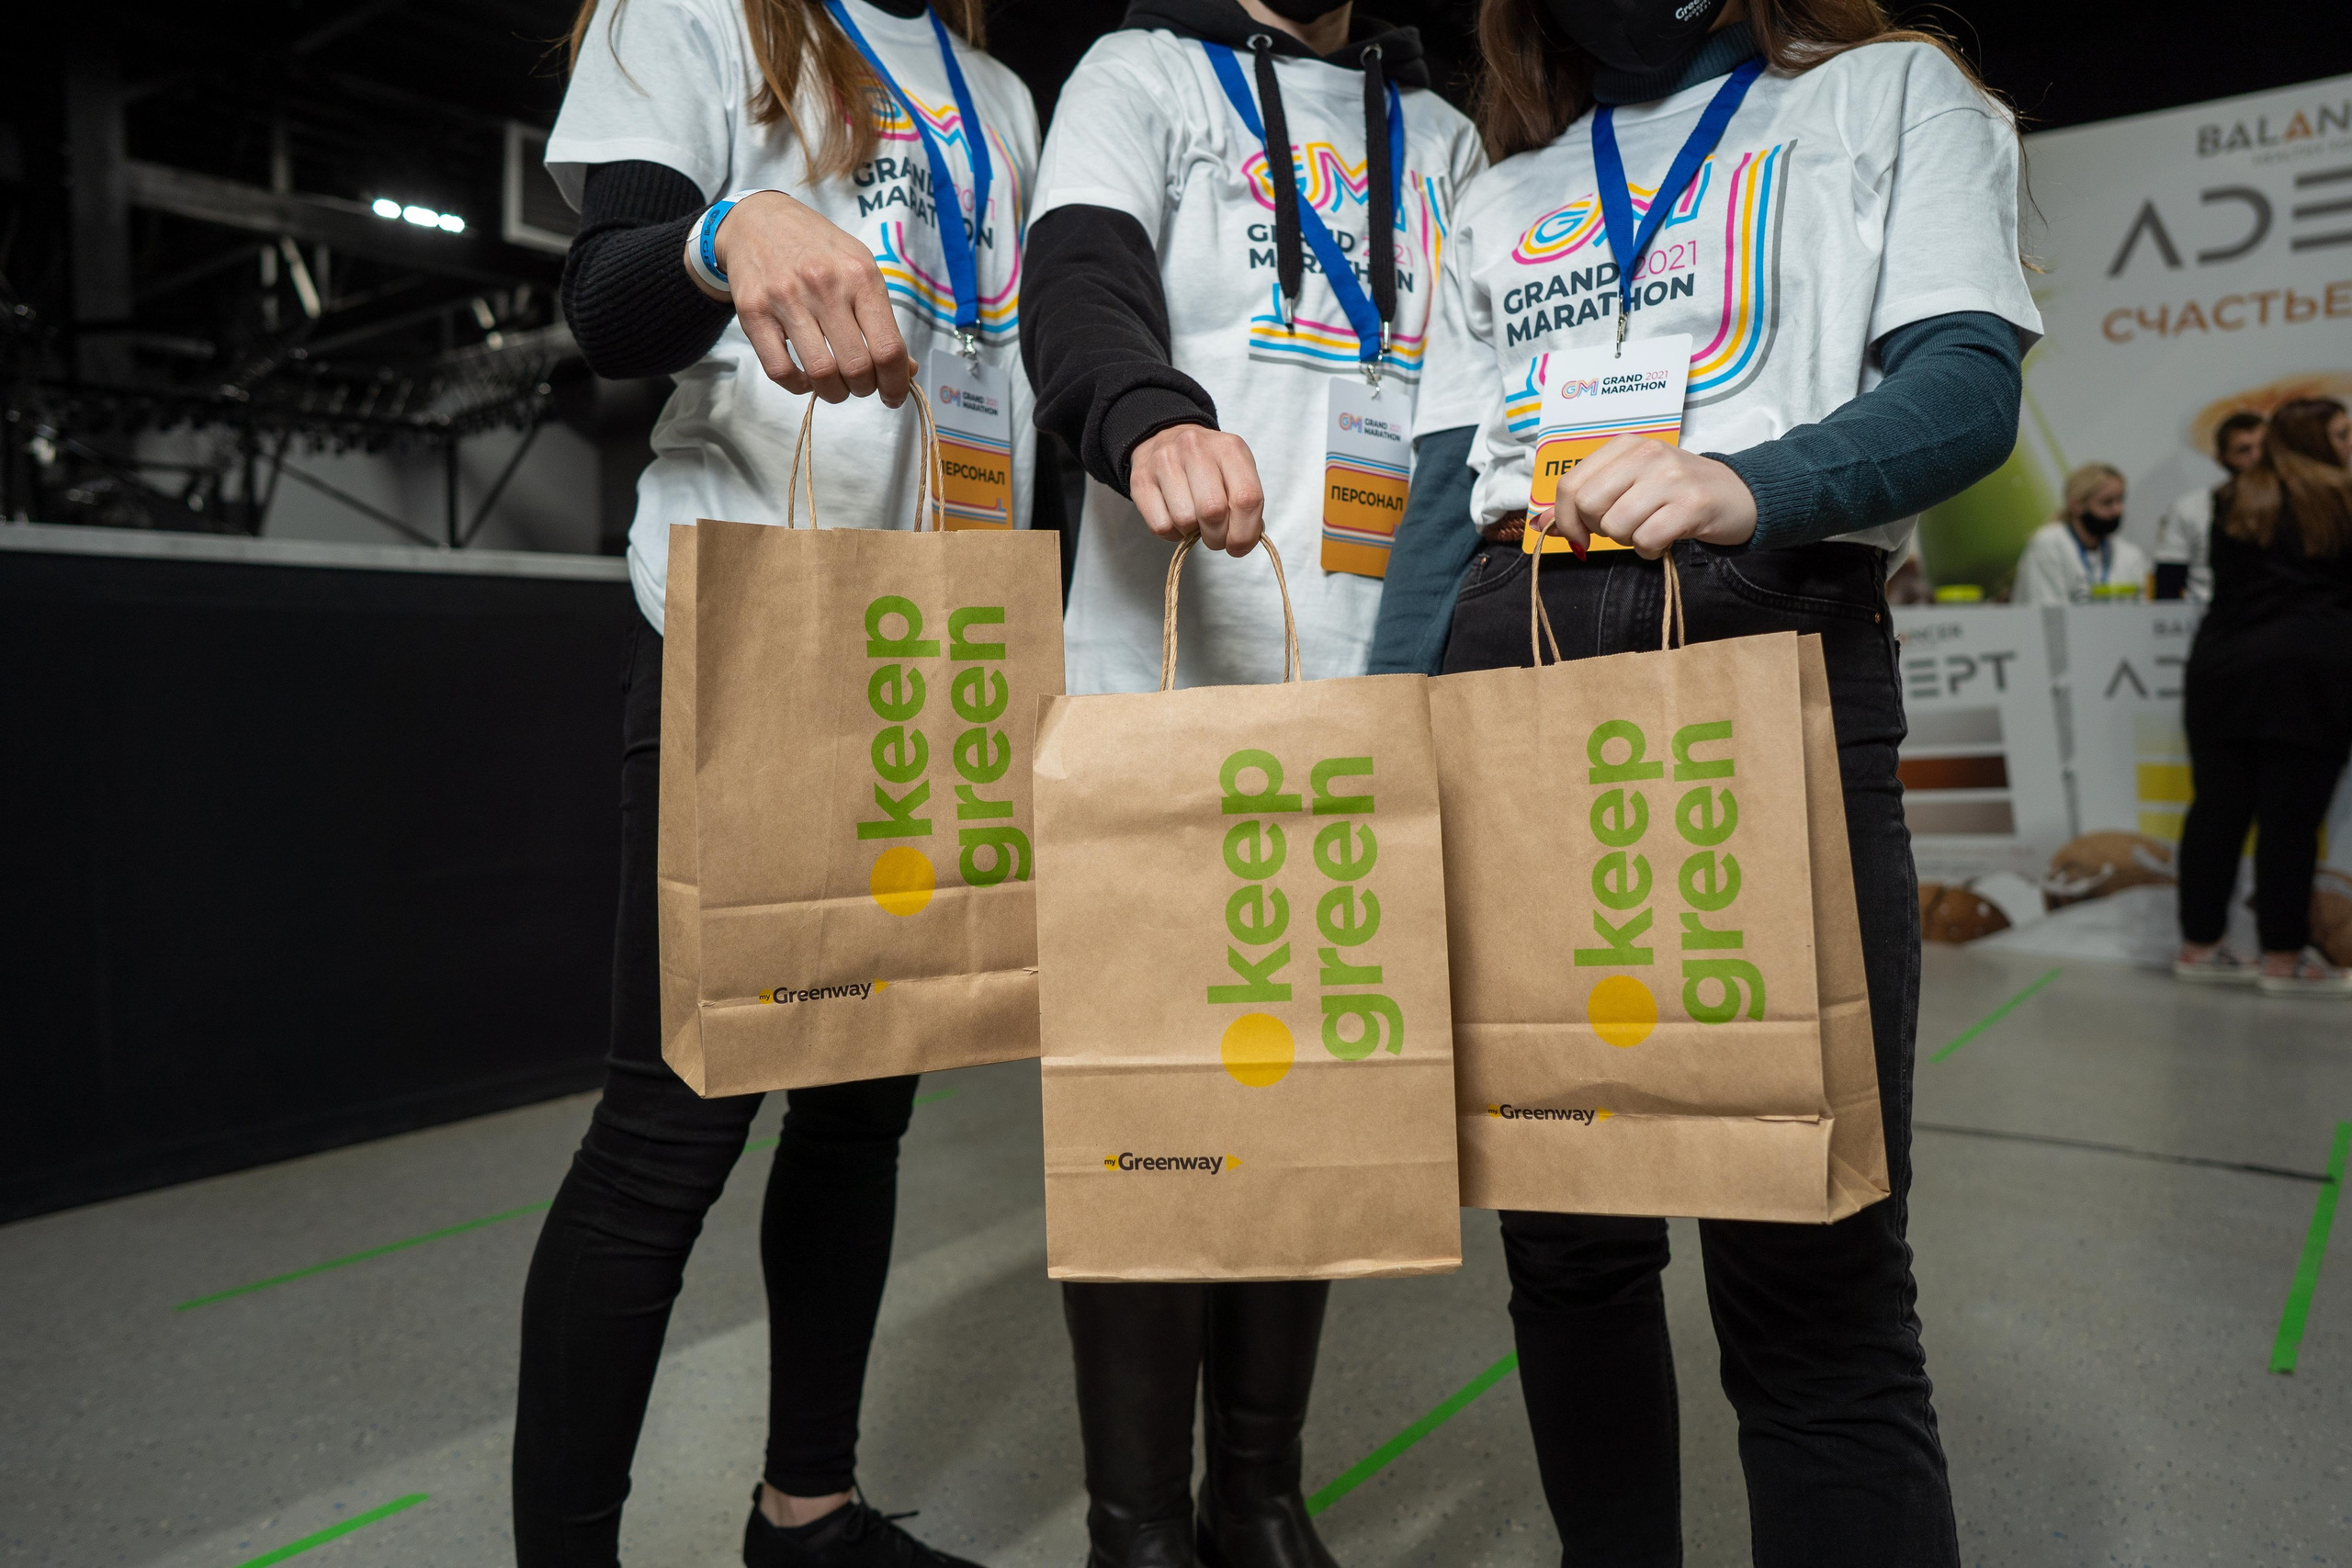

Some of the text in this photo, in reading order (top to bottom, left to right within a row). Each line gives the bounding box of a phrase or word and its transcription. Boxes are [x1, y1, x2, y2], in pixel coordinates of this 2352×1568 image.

[1503, 240, 1697, 315] GRAND 2021
[1600, 380, 1667, 395] MARATHON
[1602, 369, 1668, 386] GRAND 2021
[1363, 417, 1389, 431] GRAND
[1363, 427, 1402, 442] MARATHON
[1331, 485, 1404, 512] ПЕРСОНАЛ
[857, 594, 941, 840] keep
[947, 606, 1032, 888] green
[1574, 719, 1664, 966] keep
[1206, 749, 1303, 1004] keep
[1671, 719, 1766, 1025] green
[1310, 756, 1405, 1061] green
[773, 982, 872, 1005] Greenway
[1499, 1104, 1595, 1126] Greenway
[1118, 1152, 1223, 1176] Greenway
